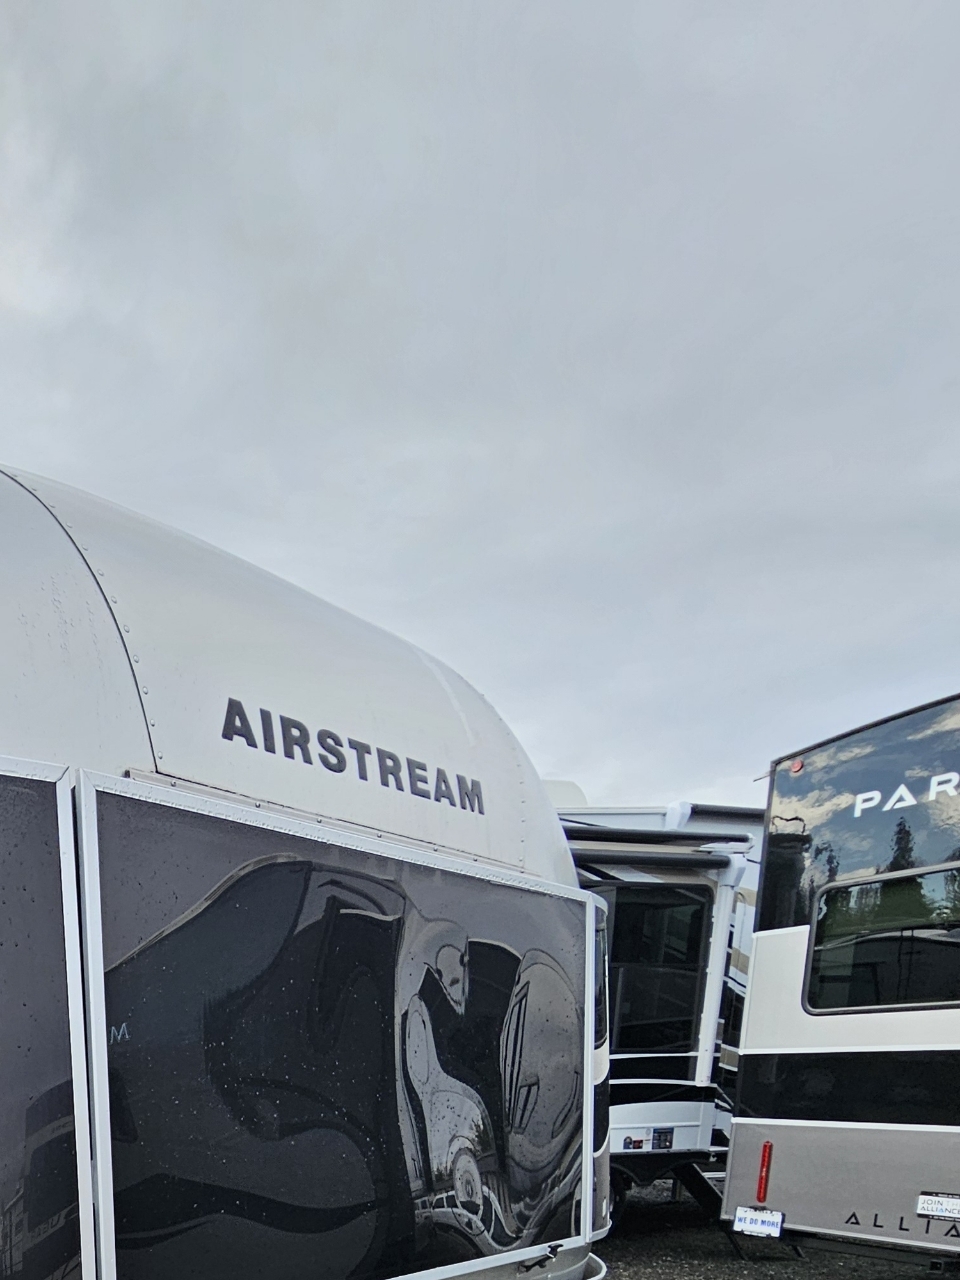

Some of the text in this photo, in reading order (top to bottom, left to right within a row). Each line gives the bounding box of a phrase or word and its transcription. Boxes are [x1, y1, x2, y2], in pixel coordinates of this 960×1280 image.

[221, 697, 486, 816] AIRSTREAM
[853, 771, 960, 818] PAR
[921, 1199, 943, 1207] JOIN
[737, 1216, 779, 1229] WE DO MORE
[844, 1211, 960, 1238] ALLIA
